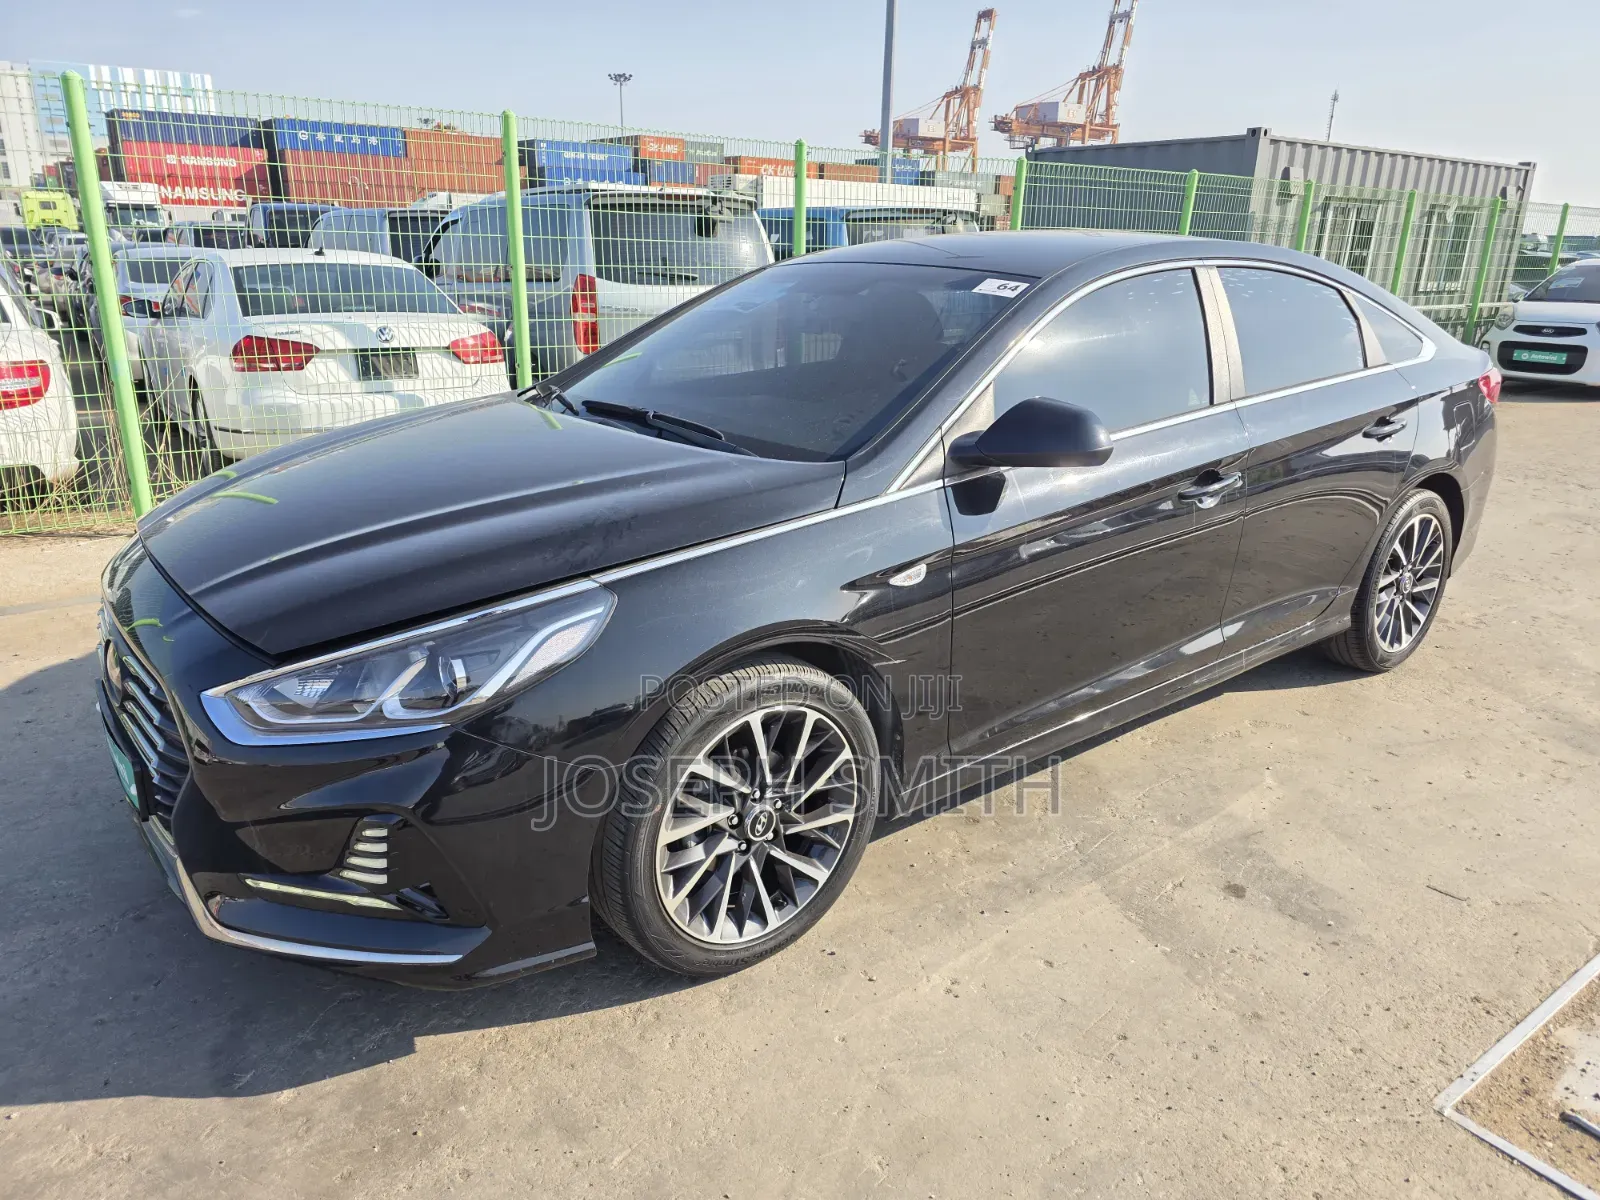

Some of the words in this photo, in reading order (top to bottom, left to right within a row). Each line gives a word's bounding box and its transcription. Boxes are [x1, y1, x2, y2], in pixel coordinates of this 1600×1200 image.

[180, 155, 237, 167] NAMSUNG
[760, 164, 775, 176] CK
[159, 185, 247, 202] NAMSUNG
[996, 282, 1021, 292] 64
